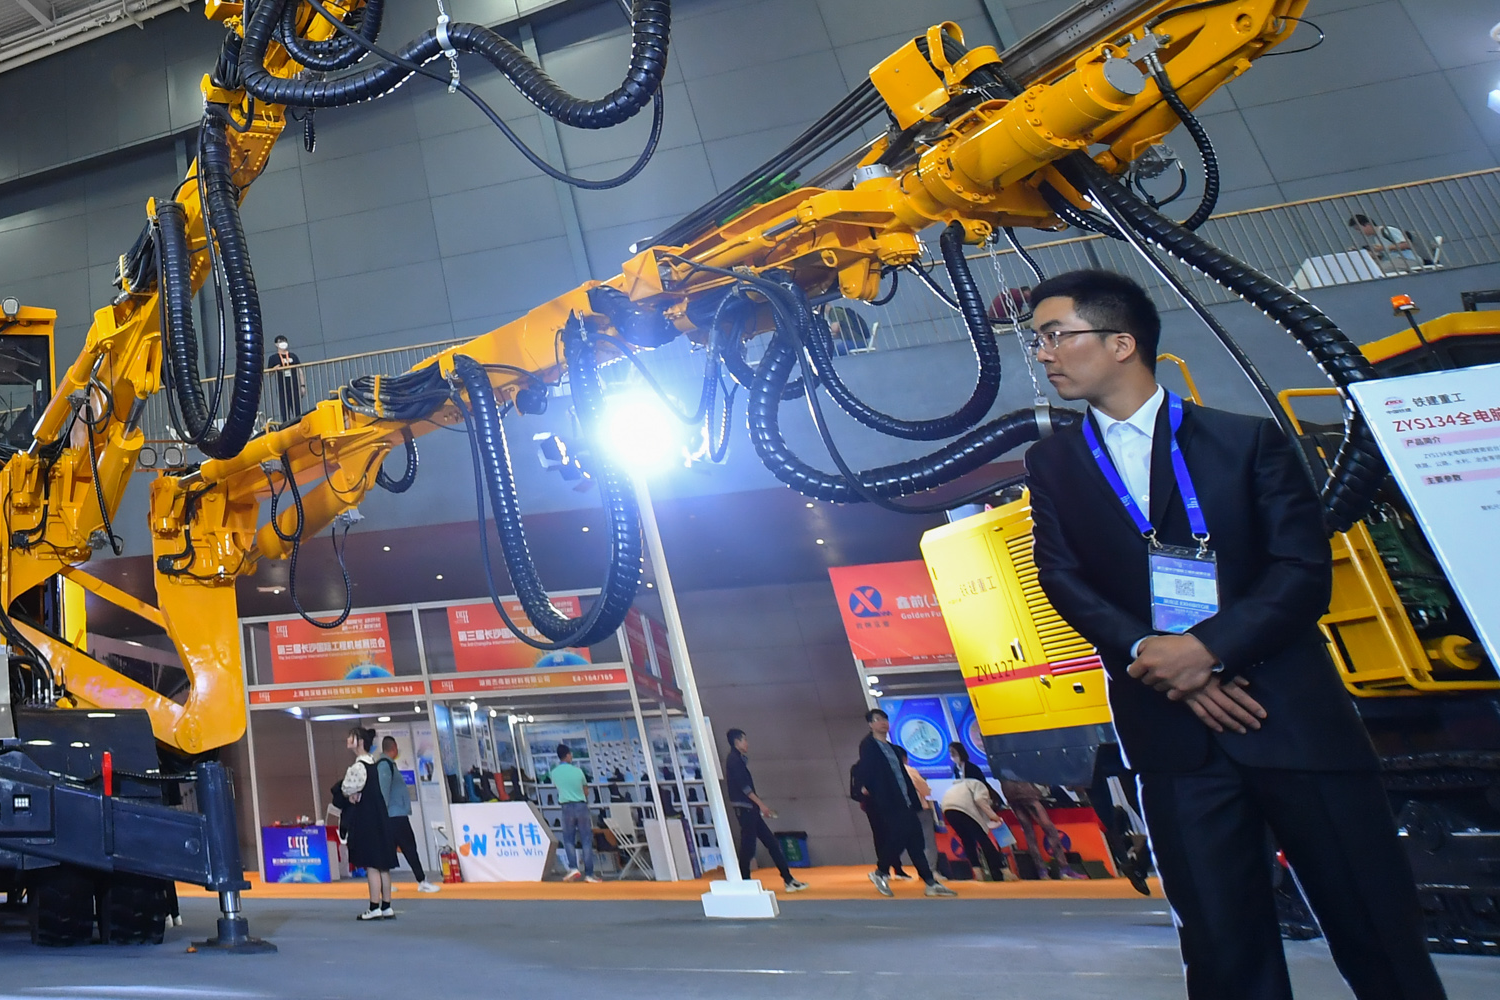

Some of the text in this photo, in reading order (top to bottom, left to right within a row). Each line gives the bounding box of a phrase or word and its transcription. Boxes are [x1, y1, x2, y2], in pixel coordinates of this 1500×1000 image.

[1412, 392, 1466, 407] 铁建重工
[1406, 436, 1441, 447] 产品简介
[1426, 474, 1463, 485] 主要参数
[901, 611, 930, 619] Golden
[974, 659, 1016, 682] ZYL127
[492, 823, 542, 847] 杰伟
[497, 847, 544, 857] Join Win
